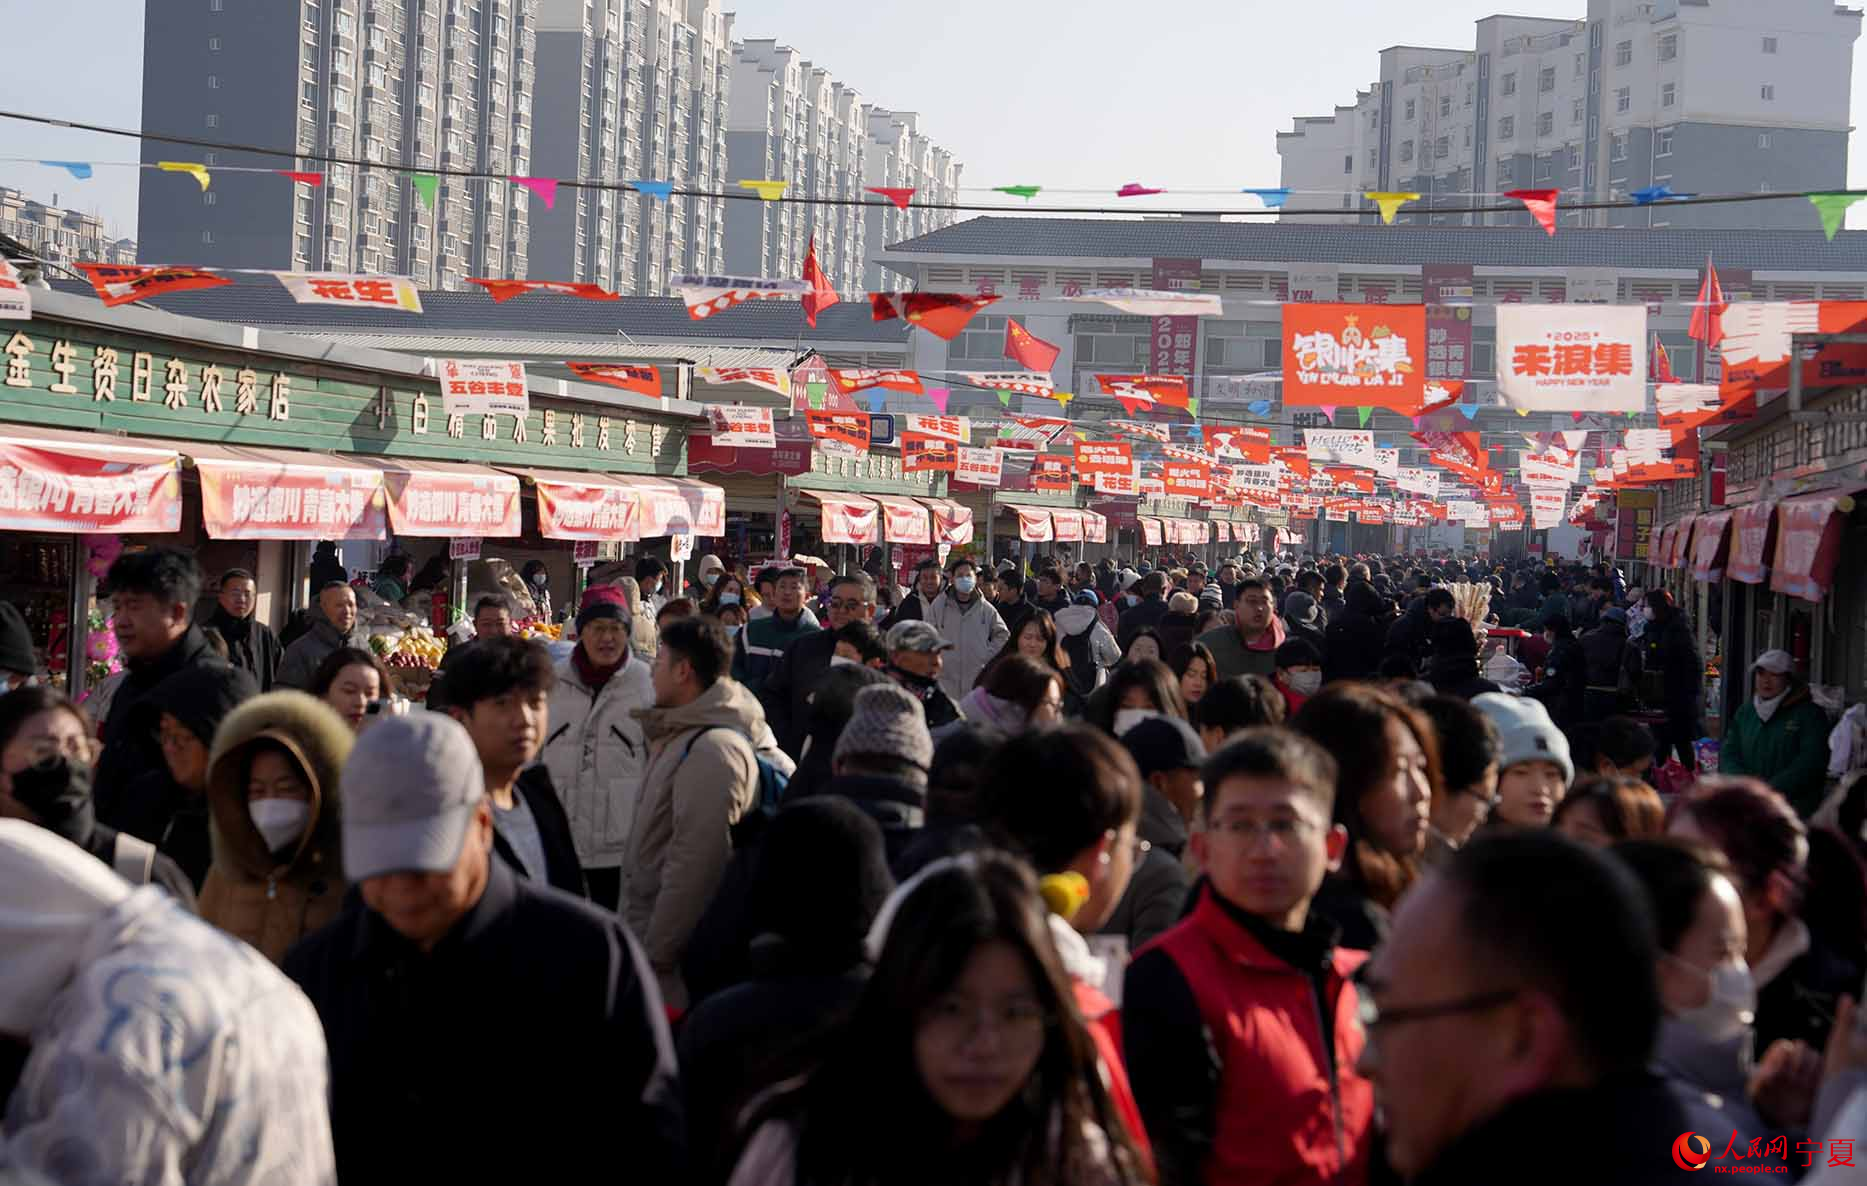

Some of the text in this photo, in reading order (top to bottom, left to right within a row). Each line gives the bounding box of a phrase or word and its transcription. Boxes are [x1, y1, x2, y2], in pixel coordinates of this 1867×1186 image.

[307, 279, 399, 305] 花生
[1296, 370, 1319, 385] YIN
[1388, 373, 1404, 386] JI
[447, 380, 525, 397] 五谷丰登
[716, 421, 771, 434] 五谷丰登
[918, 415, 960, 436] 花生
